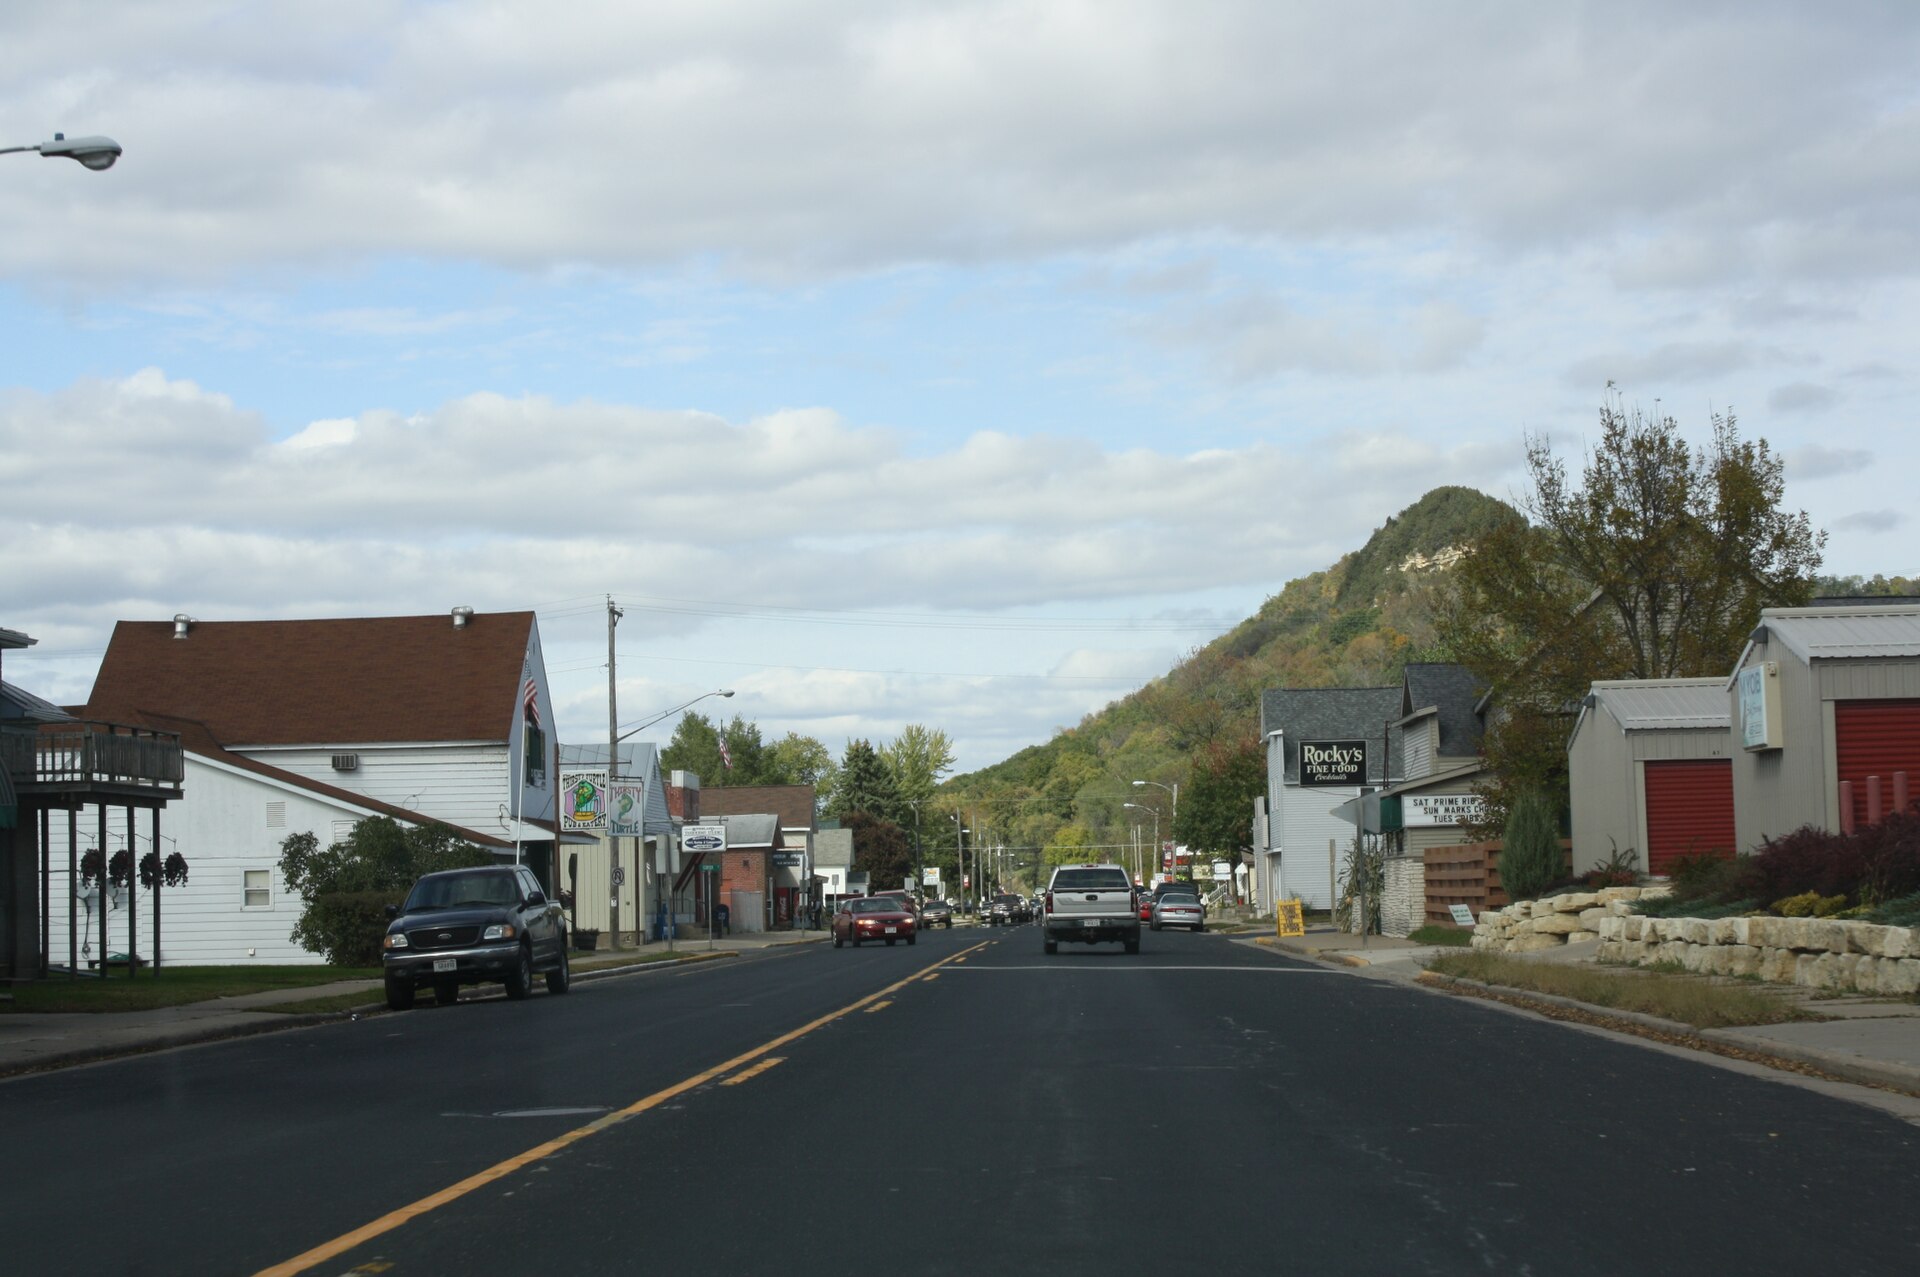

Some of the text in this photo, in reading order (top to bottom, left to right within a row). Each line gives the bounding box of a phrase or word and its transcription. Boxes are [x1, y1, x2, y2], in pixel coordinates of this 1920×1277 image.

[1303, 745, 1363, 765] Rocky's
[1306, 764, 1358, 773] FINE FOOD
[562, 773, 606, 790] THIRSTY TURTLE
[1314, 773, 1347, 781] Cocktails
[609, 786, 642, 803] THIRSTY
[1413, 798, 1429, 807] SAT
[1433, 797, 1459, 806] PRIME
[1423, 806, 1439, 815] SUN
[1443, 805, 1471, 814] MARKS
[563, 815, 577, 828] PUB
[582, 813, 607, 828] EATERY
[1433, 815, 1453, 823] TUES
[610, 820, 639, 834] TURTLE
